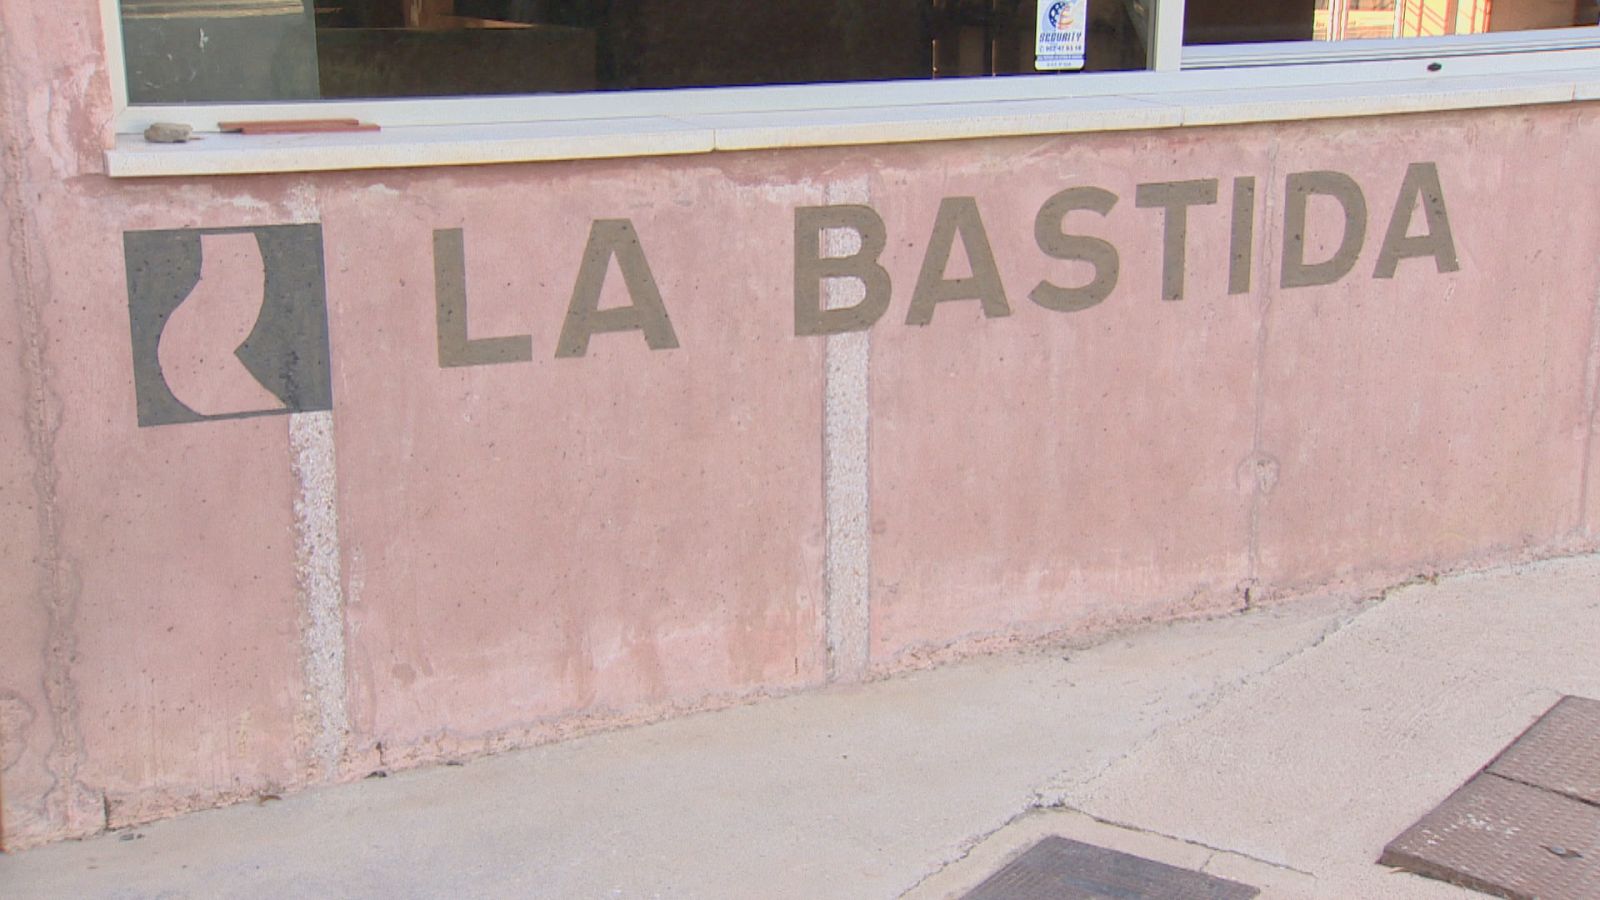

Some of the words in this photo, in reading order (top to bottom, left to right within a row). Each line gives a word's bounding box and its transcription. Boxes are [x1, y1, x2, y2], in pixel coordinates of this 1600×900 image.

[1039, 32, 1081, 42] SECURITY
[434, 218, 680, 367] LA
[795, 162, 1460, 336] BASTIDA
